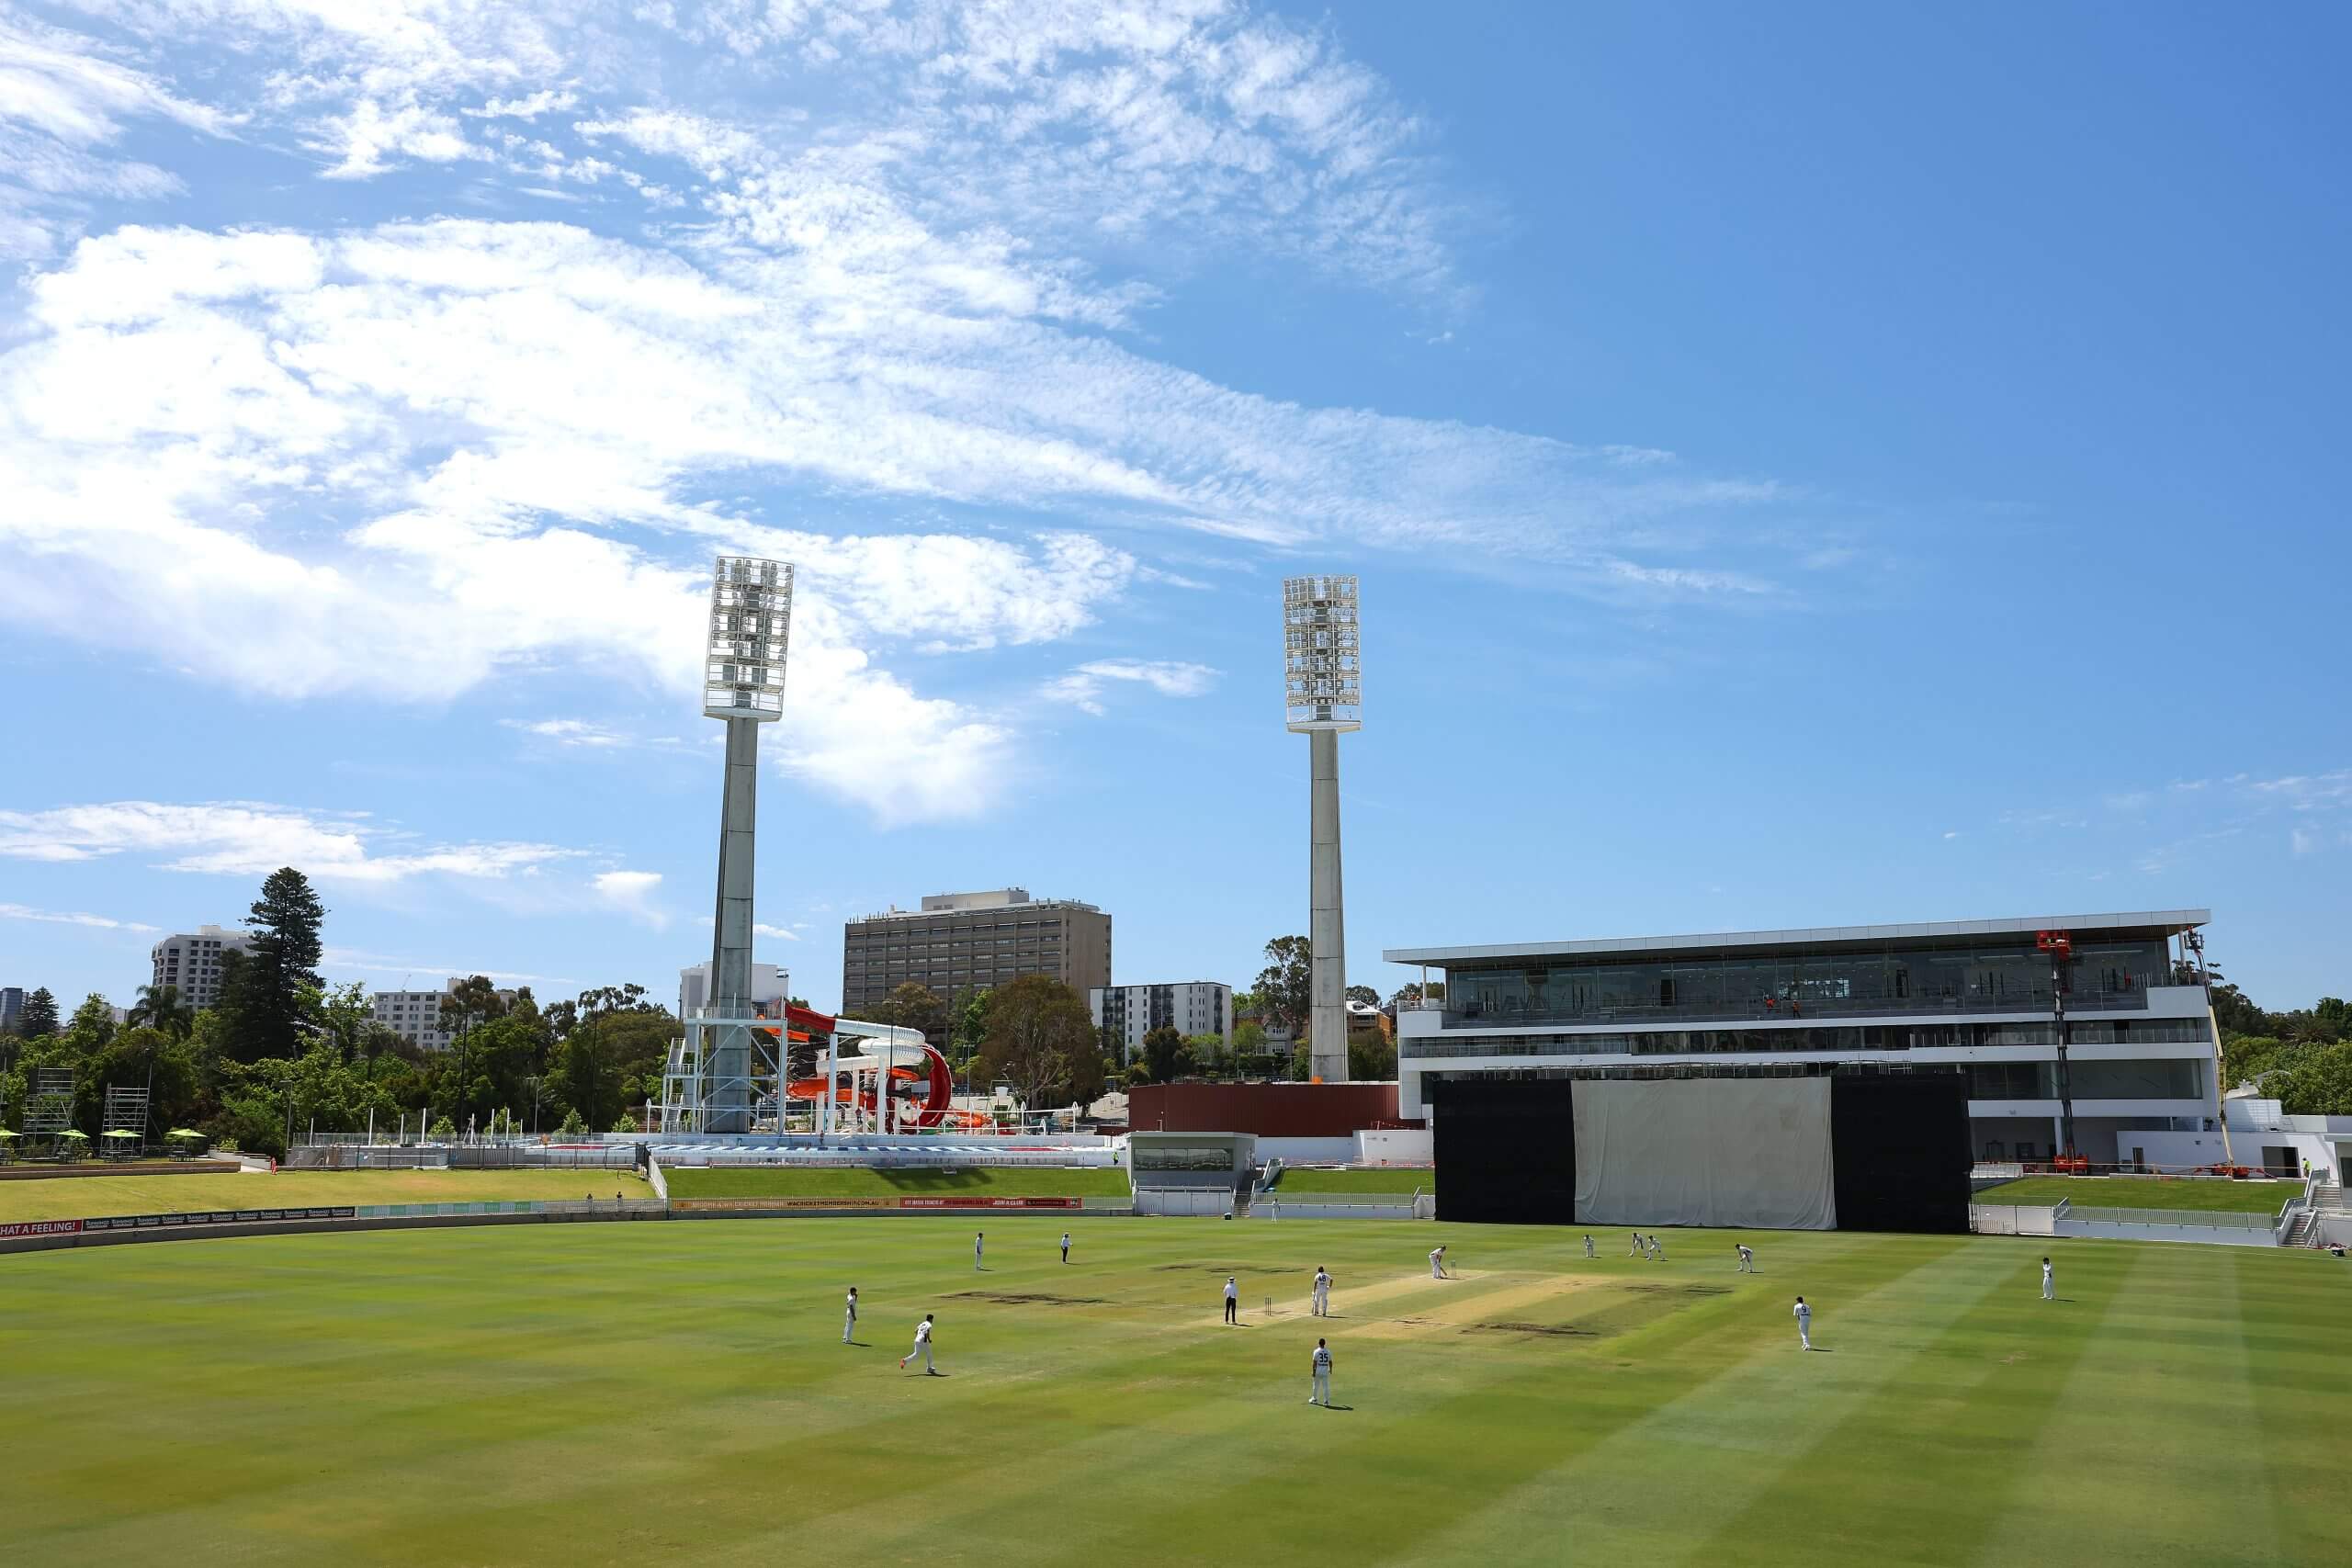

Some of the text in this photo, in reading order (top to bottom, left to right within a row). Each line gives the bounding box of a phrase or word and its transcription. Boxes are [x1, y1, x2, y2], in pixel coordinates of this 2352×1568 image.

[22, 1224, 29, 1235] A
[31, 1222, 75, 1234] FEELING!
[1319, 1352, 1329, 1363] 35
